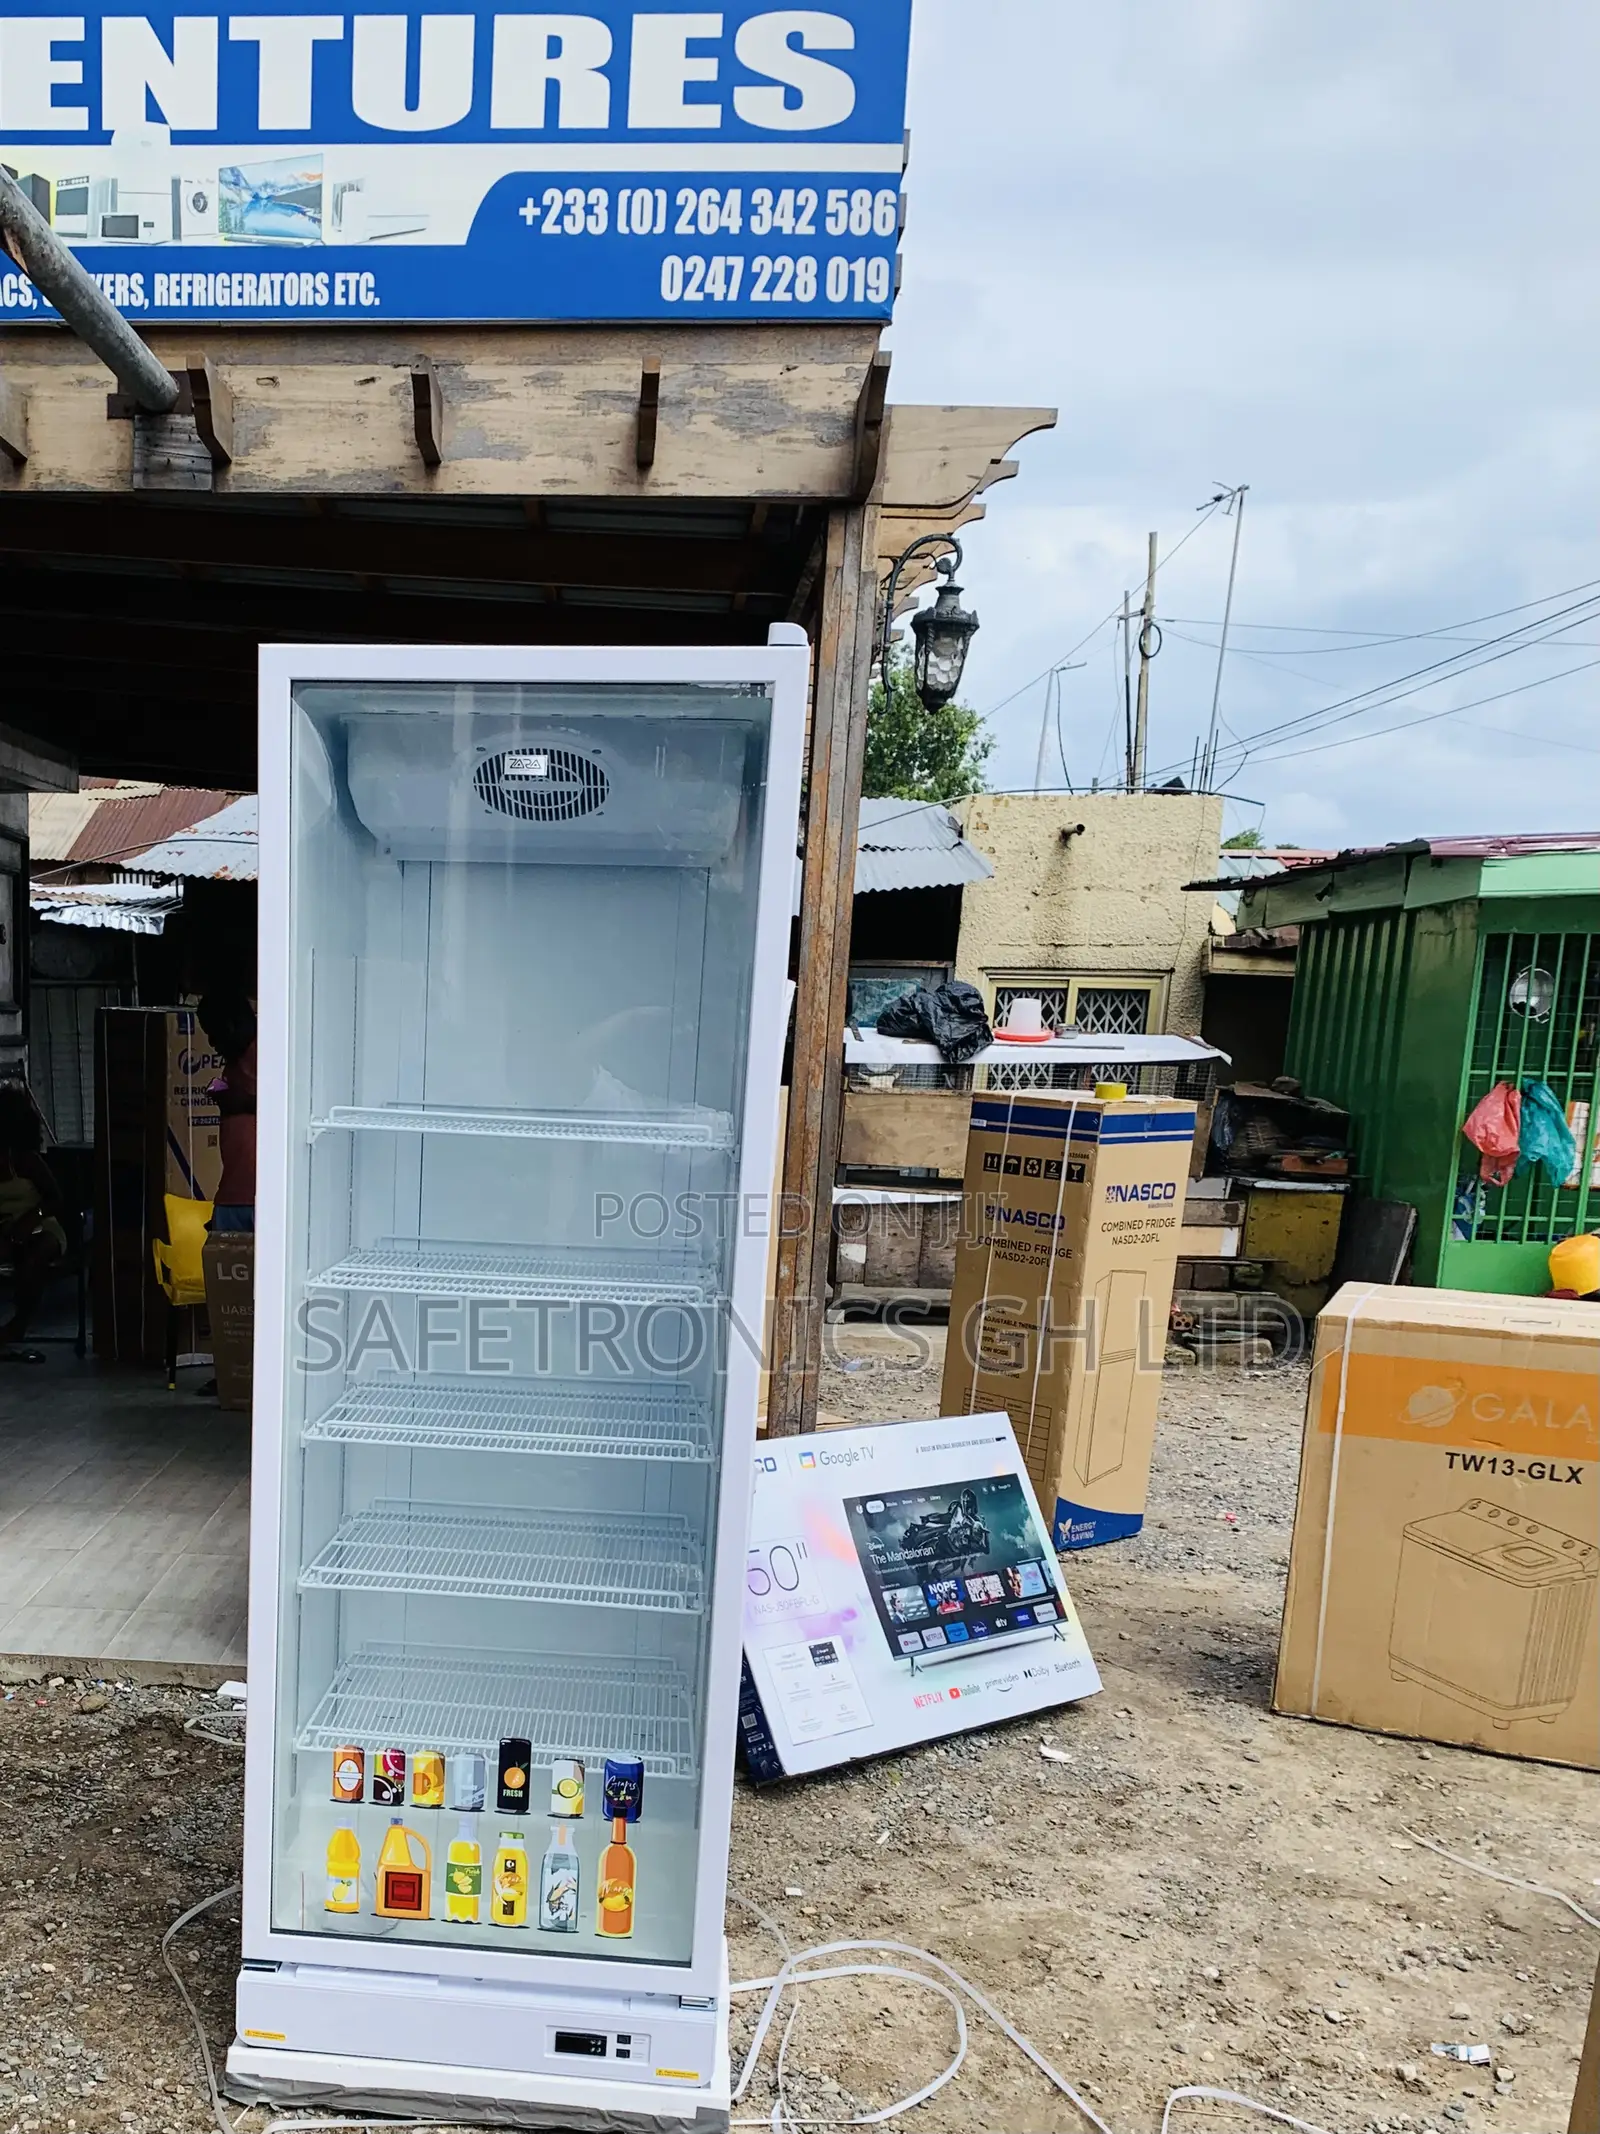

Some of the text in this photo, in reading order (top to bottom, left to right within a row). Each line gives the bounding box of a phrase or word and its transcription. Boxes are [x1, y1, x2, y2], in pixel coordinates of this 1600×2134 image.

[0, 10, 856, 131] ENTURES
[518, 188, 897, 236] +233 (0) 264 342 586
[660, 255, 890, 303] 0247 228 019
[0, 273, 38, 310] CS,
[154, 272, 329, 306] REFRIGERATORS
[334, 272, 381, 307] ETC.
[509, 758, 542, 769] ZARA
[201, 1054, 227, 1069] PEA
[1115, 1182, 1177, 1203] NASCO
[997, 1206, 1066, 1231] NASCO
[1100, 1217, 1177, 1233] COMBINED FRIDGE
[978, 1236, 1032, 1252] COMBINED
[1111, 1232, 1160, 1246] NASD2-20FL
[216, 1262, 249, 1281] LG
[1471, 1393, 1593, 1431] GALA
[820, 1445, 875, 1467] Google TV
[1445, 1451, 1585, 1485] TW13-GLX
[1071, 1521, 1097, 1533] ENERGY
[1071, 1531, 1095, 1542] SAVING
[870, 1546, 935, 1565] The Mandalorian
[928, 1580, 959, 1595] NOPE
[912, 1691, 945, 1709] NETFLIX
[1001, 1673, 1020, 1685] video
[502, 1788, 524, 1798] FRESH
